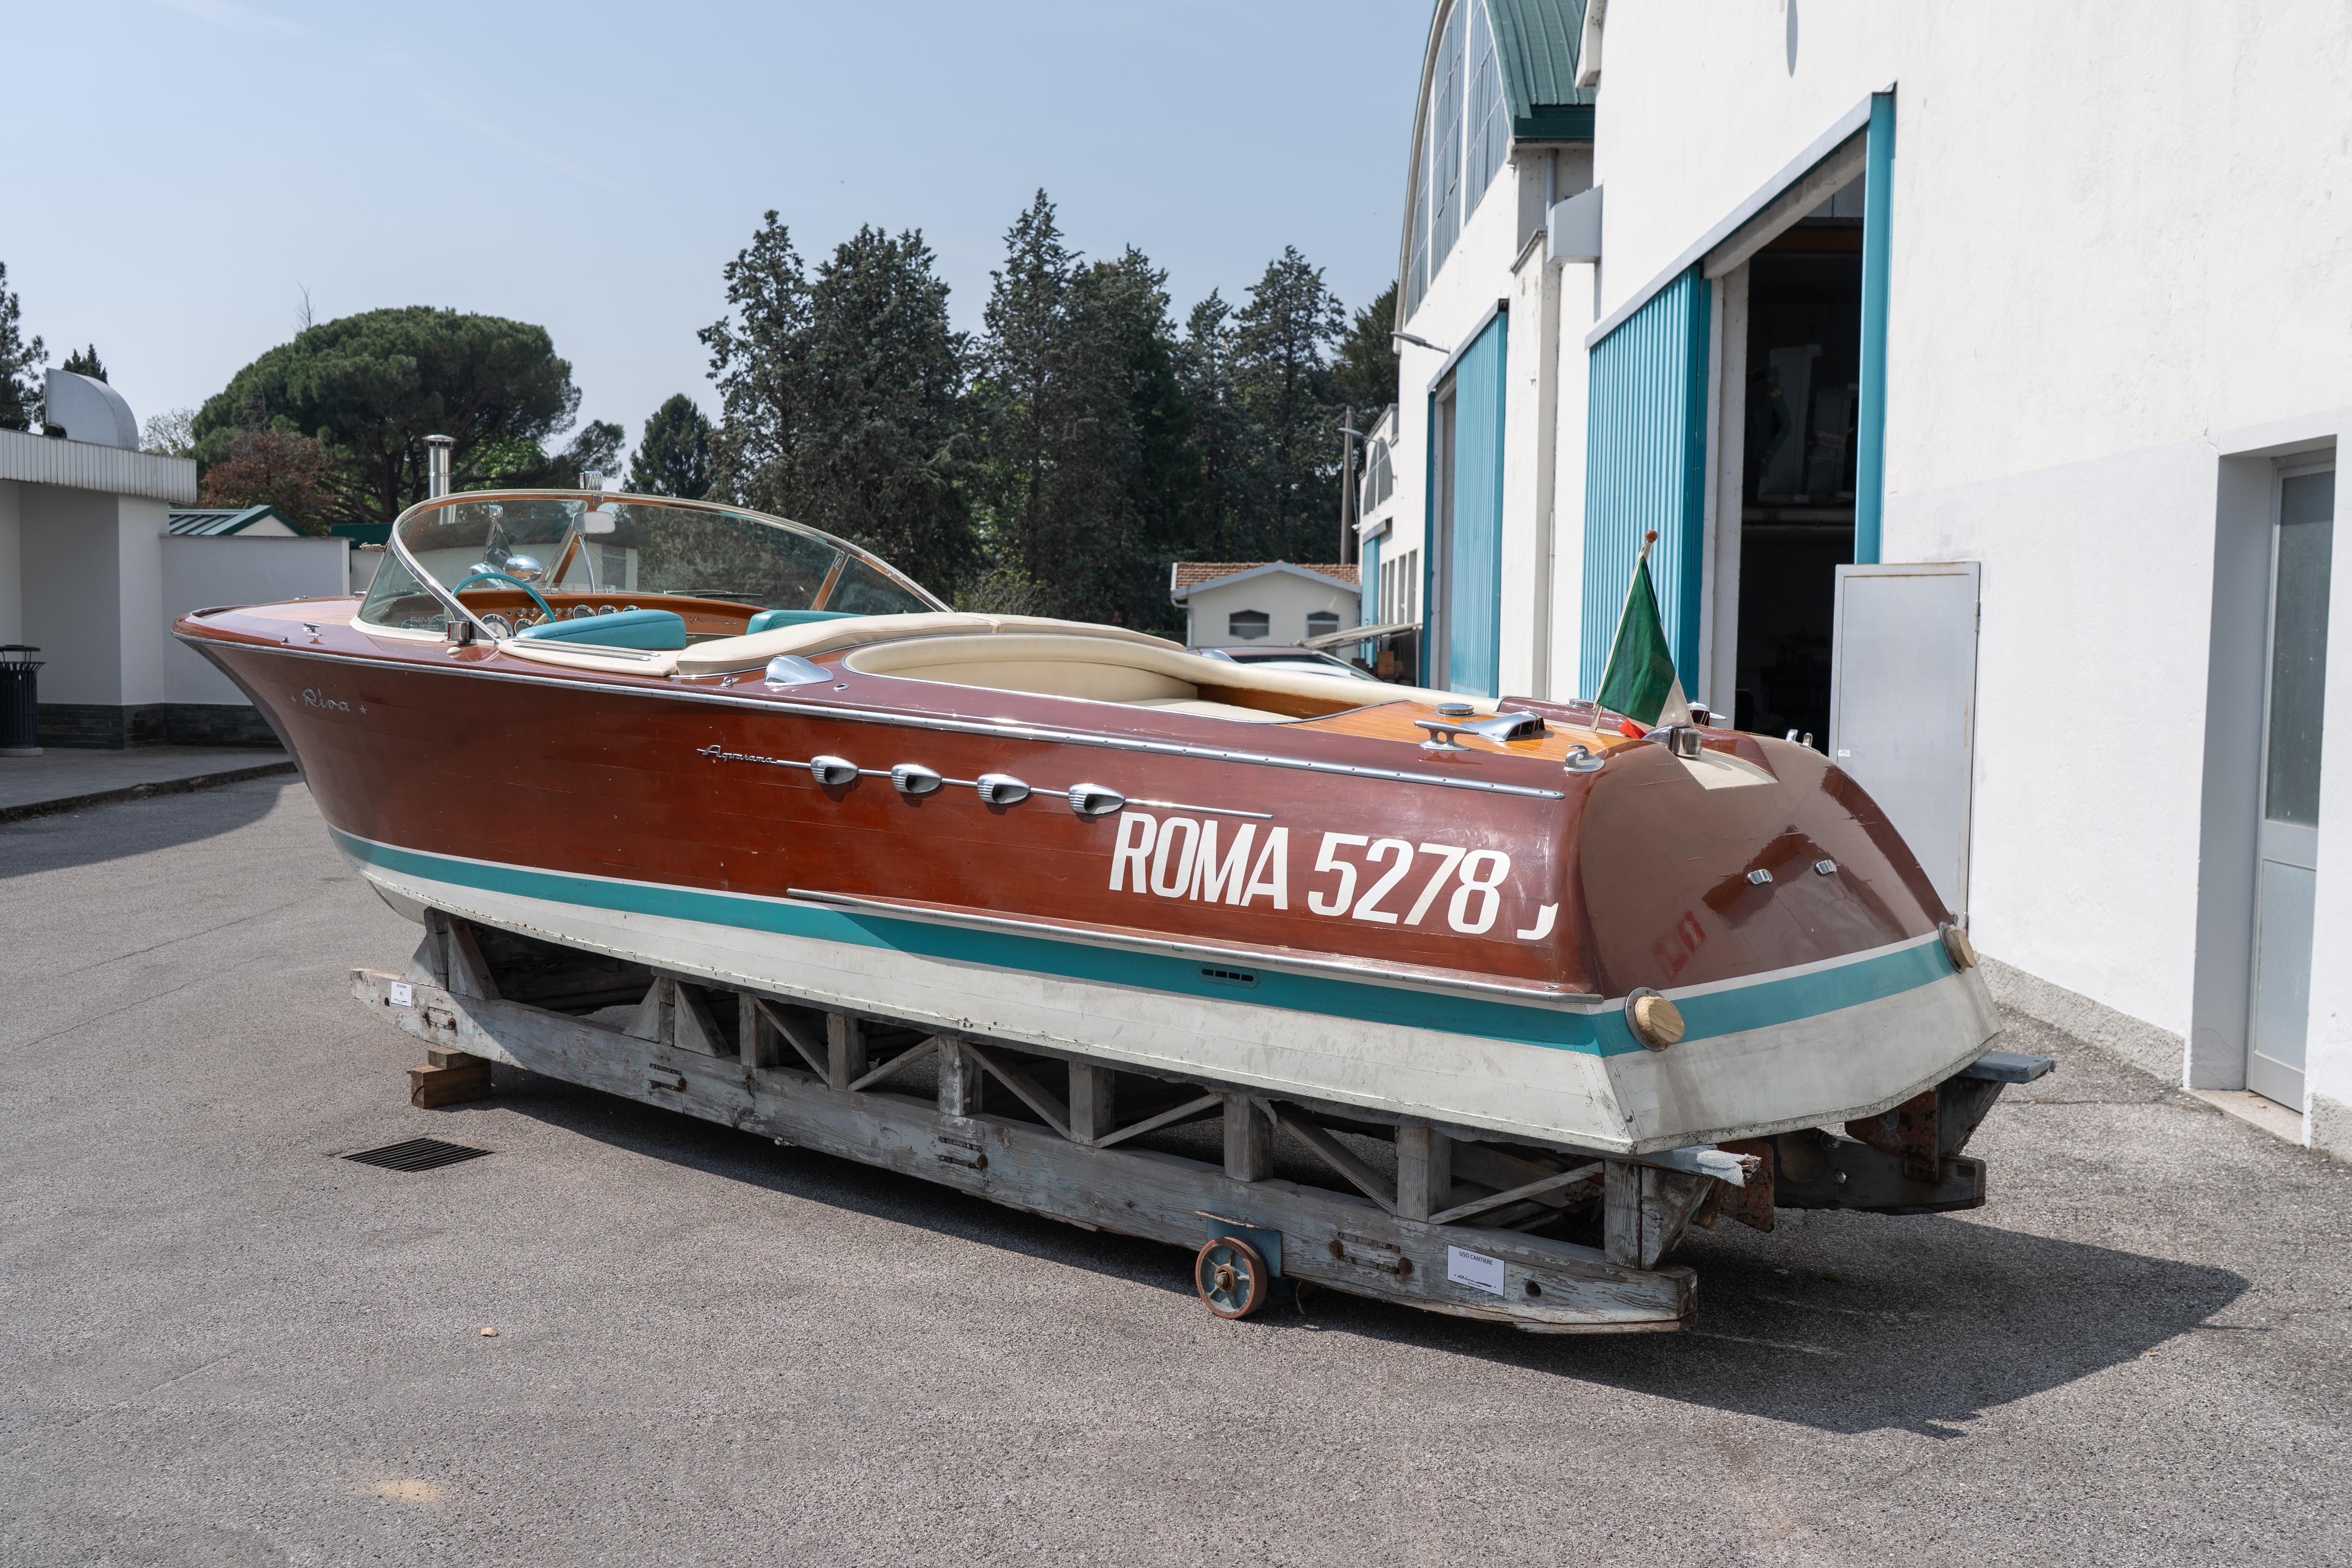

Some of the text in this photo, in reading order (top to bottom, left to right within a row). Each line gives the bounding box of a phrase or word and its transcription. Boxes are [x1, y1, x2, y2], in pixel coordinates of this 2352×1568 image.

[302, 689, 351, 712] Riva
[697, 745, 777, 763] Aquarama
[1109, 811, 1289, 909] ROMA
[1470, 1254, 1493, 1265] CANTIERE
